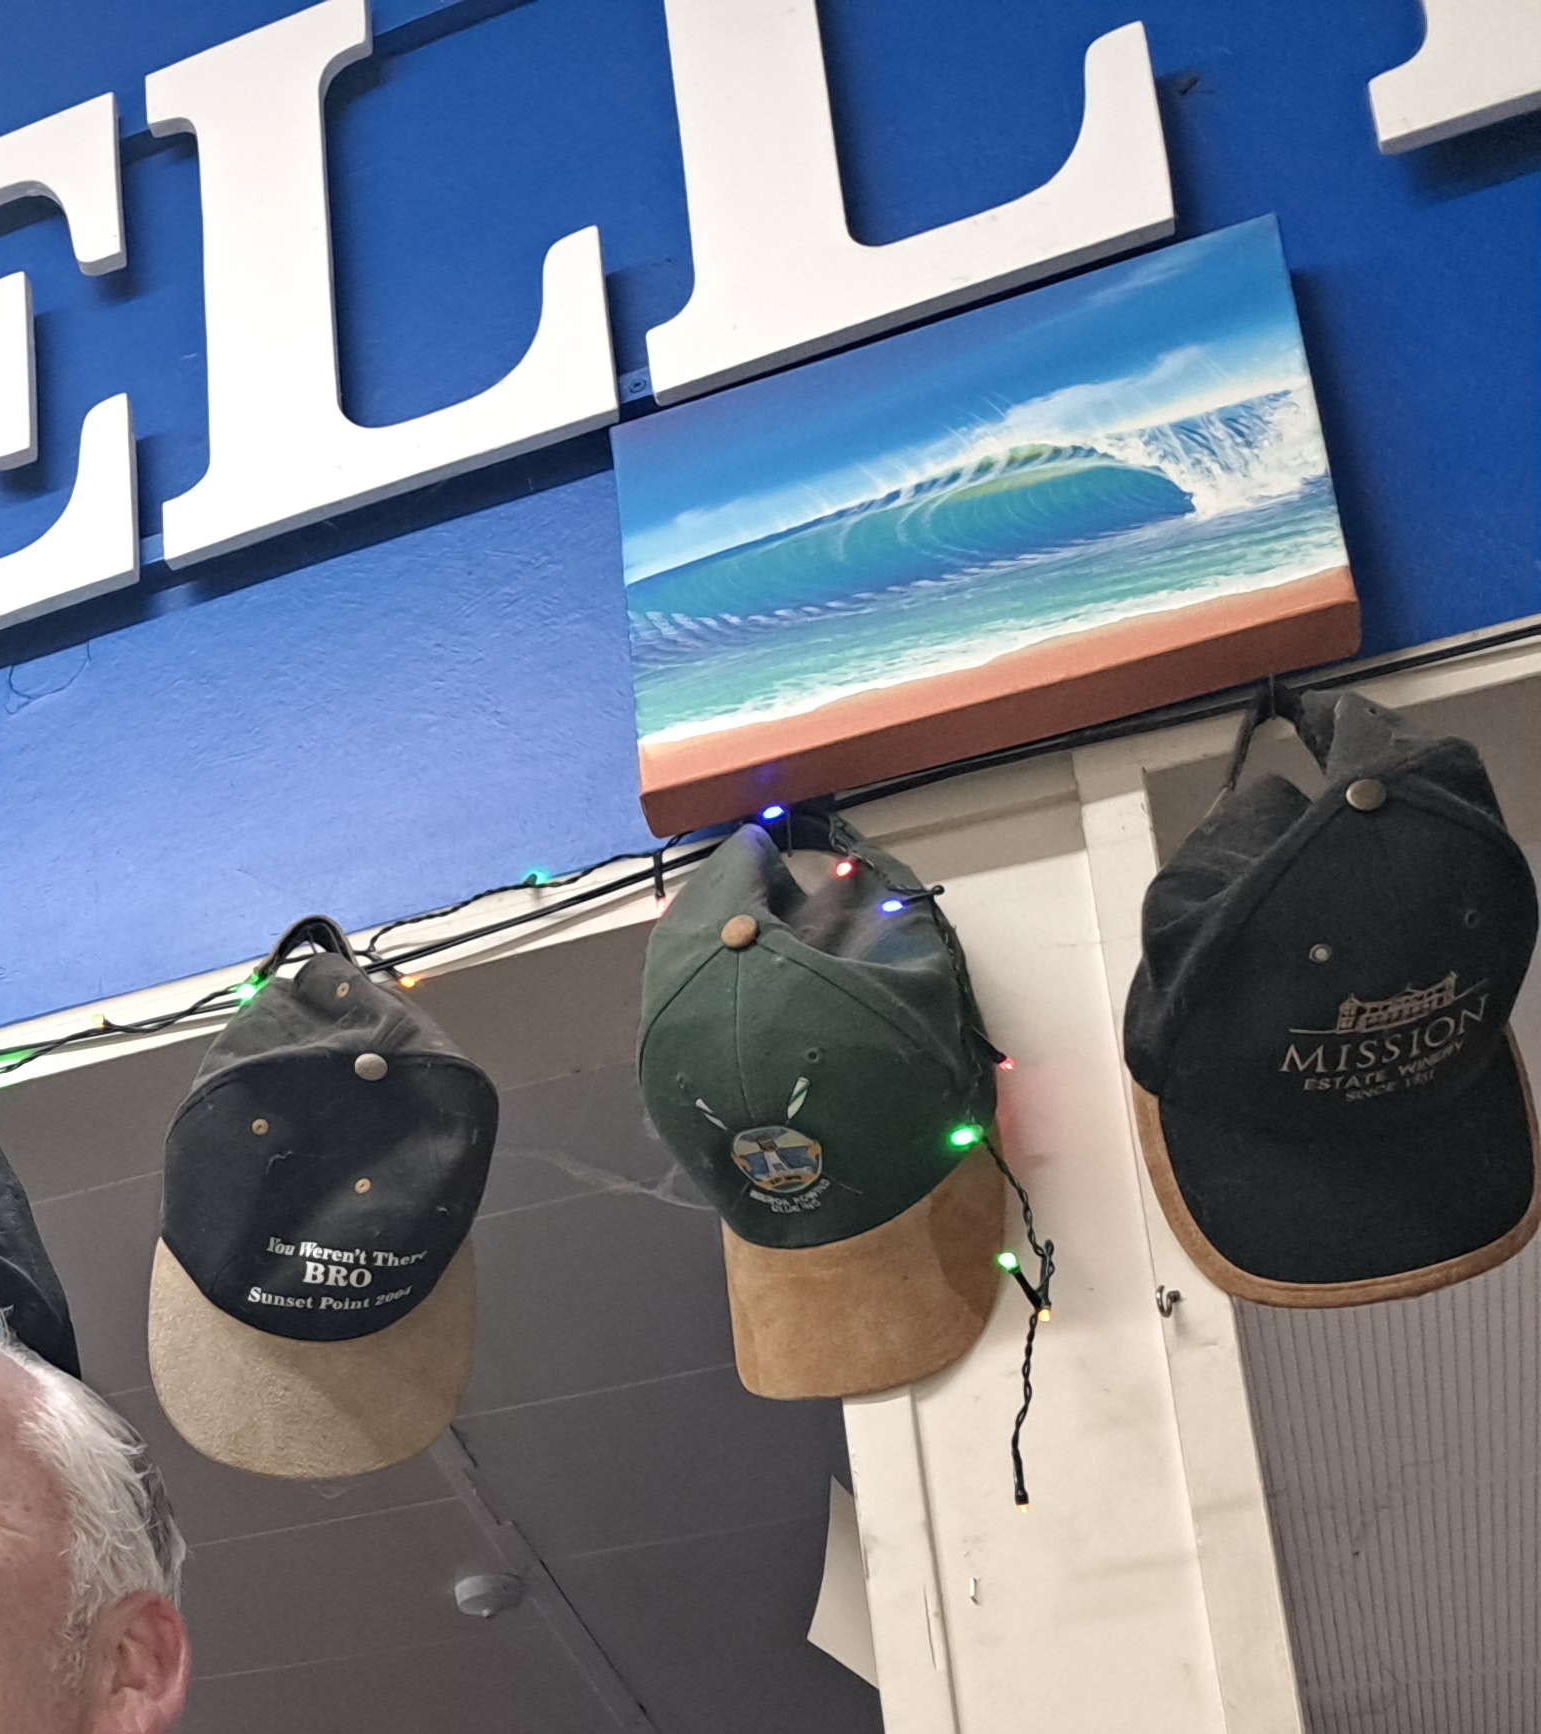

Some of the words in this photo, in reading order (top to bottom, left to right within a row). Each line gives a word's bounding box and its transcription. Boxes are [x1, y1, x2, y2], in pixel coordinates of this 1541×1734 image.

[1279, 994, 1489, 1073] MISSION
[1303, 1069, 1388, 1092] ESTATE
[267, 1236, 295, 1257] You
[299, 1241, 367, 1266] Weren't
[302, 1260, 374, 1289] BRO
[247, 1286, 314, 1310] Sunset
[318, 1296, 371, 1310] Point
